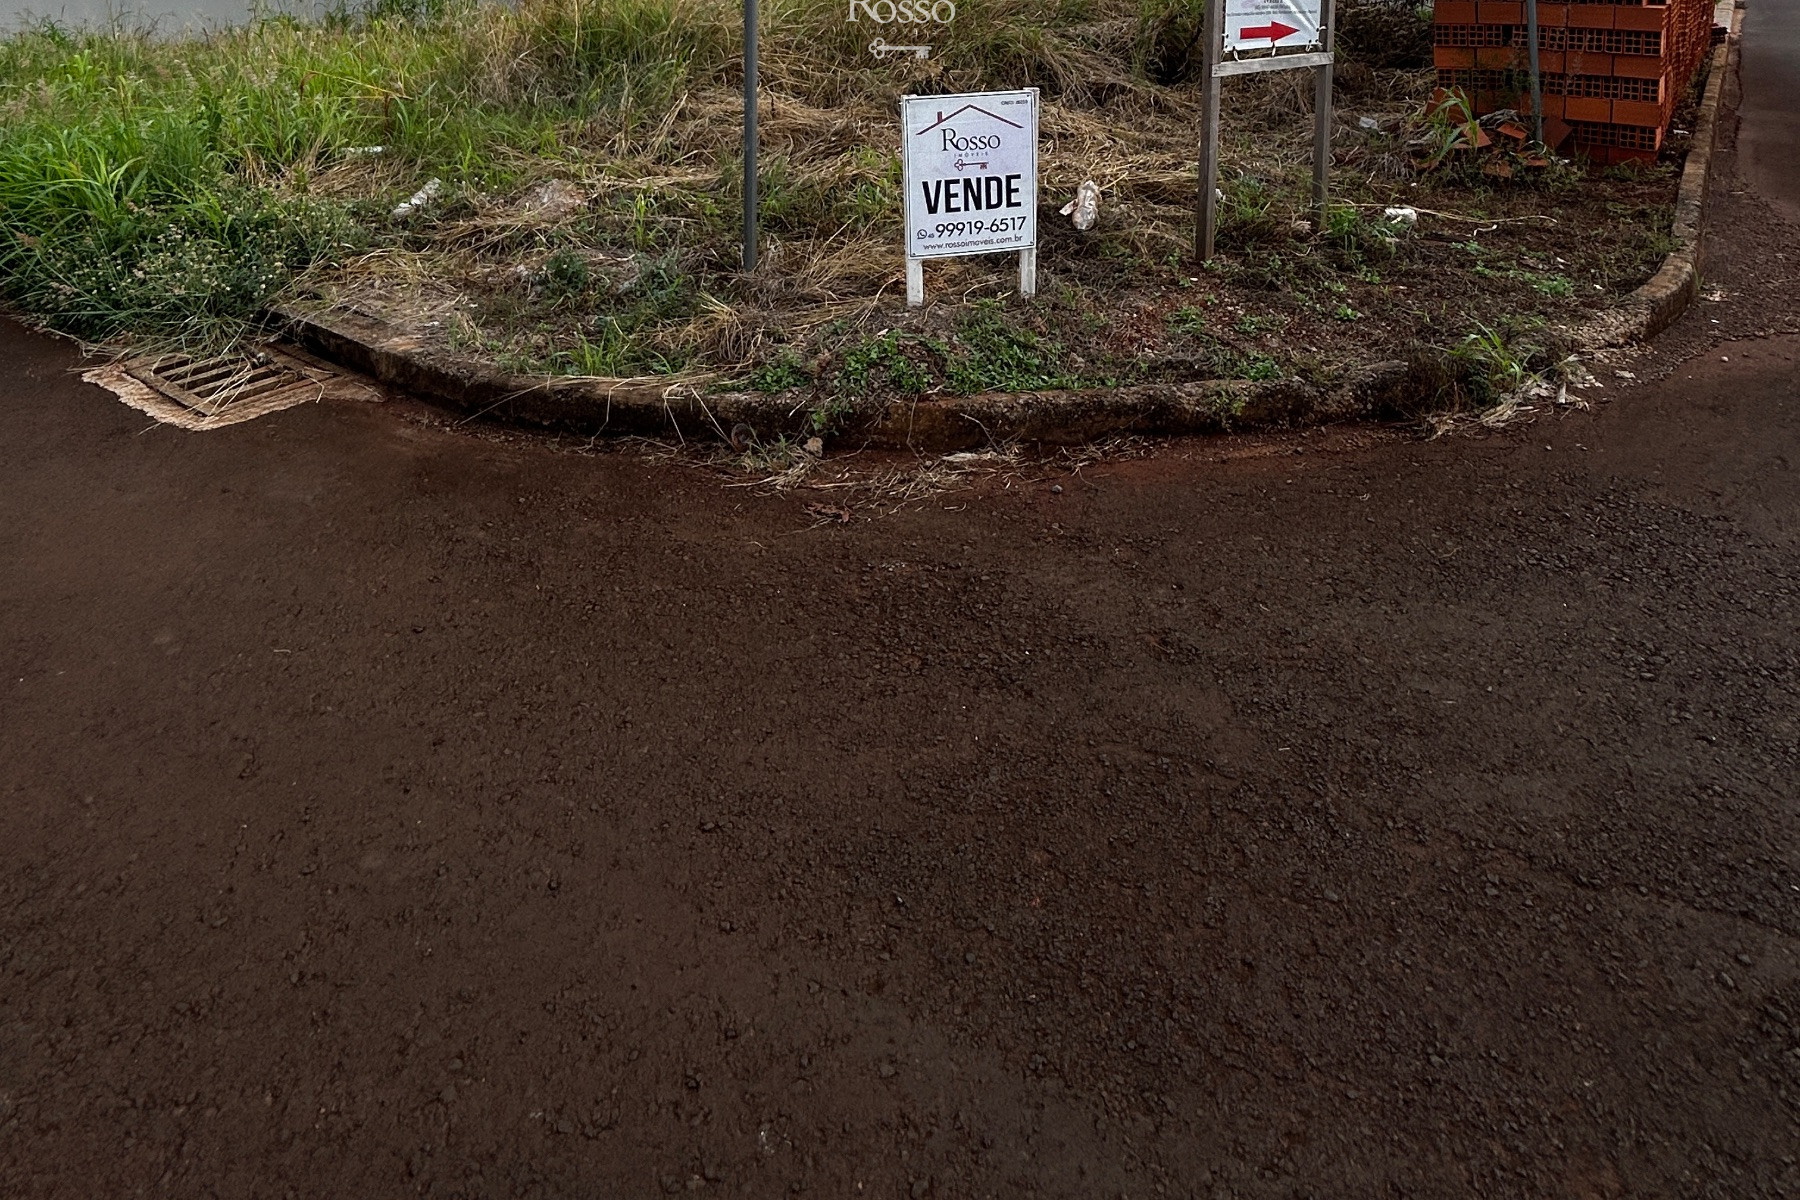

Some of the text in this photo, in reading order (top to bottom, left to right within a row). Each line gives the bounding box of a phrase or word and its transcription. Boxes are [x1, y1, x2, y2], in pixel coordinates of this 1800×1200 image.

[921, 173, 1022, 215] VENDE
[935, 215, 1027, 238] 99919-6517
[922, 233, 1023, 251] www.rossoimoveis.com.br
